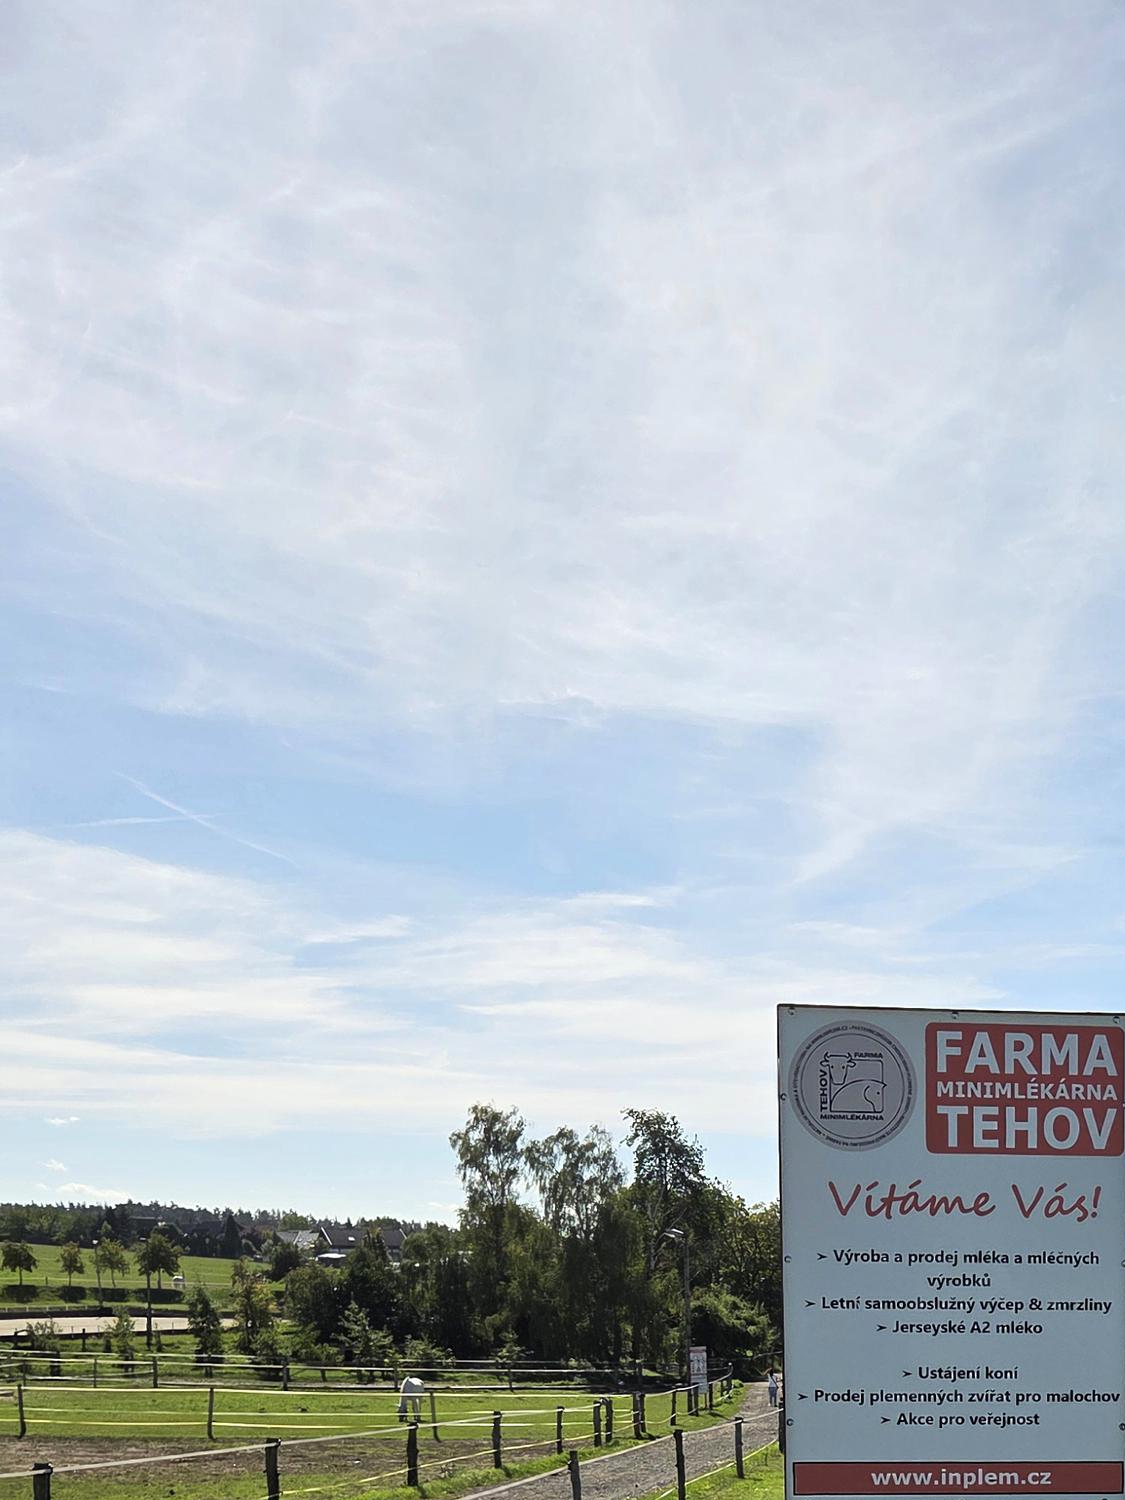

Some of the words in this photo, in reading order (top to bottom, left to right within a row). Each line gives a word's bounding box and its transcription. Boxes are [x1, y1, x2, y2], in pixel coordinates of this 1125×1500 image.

[937, 1031, 1118, 1076] FARMA
[820, 1070, 828, 1112] TEHOV
[937, 1078, 1117, 1100] MINIMLÉKÁRNA
[937, 1106, 1117, 1150] TEHOV
[829, 1179, 996, 1220] Vítáme
[1012, 1183, 1102, 1222] Vás!
[833, 1249, 889, 1266] Výroba
[894, 1253, 902, 1263] a
[908, 1250, 958, 1266] prodej
[963, 1250, 1009, 1264] mléka
[1015, 1254, 1022, 1264] a
[1028, 1251, 1099, 1267] mléčných
[927, 1273, 991, 1289] výrobků
[822, 1297, 861, 1309] Letní
[865, 1297, 975, 1313] samoobslužný
[980, 1298, 1023, 1313] výčep
[1029, 1299, 1043, 1311] &
[1047, 1299, 1112, 1314] zmrzliny
[893, 1321, 966, 1337] Jerseyské
[971, 1322, 991, 1333] A2
[996, 1321, 1043, 1334] mléko
[918, 1366, 981, 1382] Ustájení
[986, 1367, 1018, 1379] koní
[814, 1390, 864, 1405] Prodej
[870, 1390, 963, 1405] plemenných
[968, 1390, 1011, 1403] zvířat
[1016, 1394, 1041, 1406] pro
[1047, 1391, 1120, 1403] malochov
[897, 1413, 933, 1425] Akce
[939, 1416, 965, 1428] pro
[970, 1413, 1040, 1428] veřejnost
[872, 1469, 1052, 1488] www.inplem.cz
